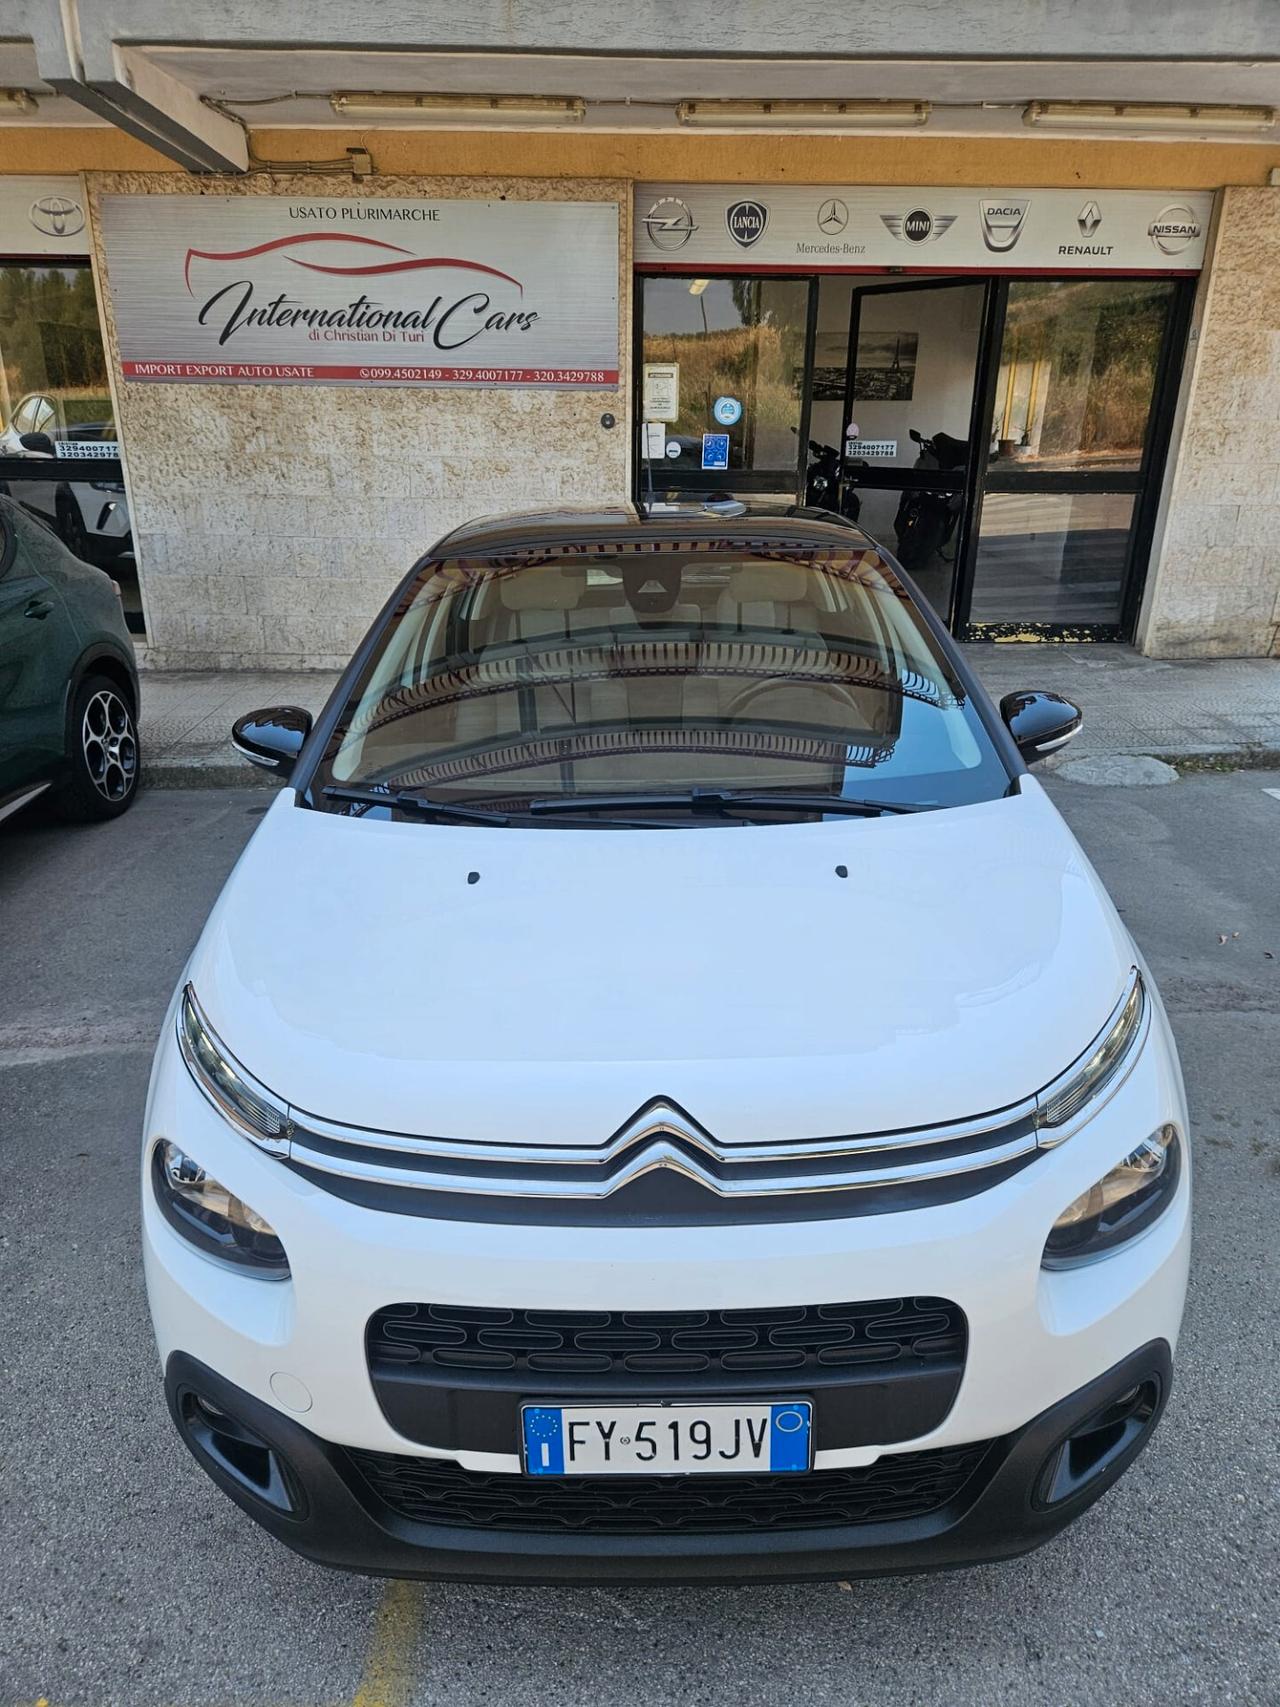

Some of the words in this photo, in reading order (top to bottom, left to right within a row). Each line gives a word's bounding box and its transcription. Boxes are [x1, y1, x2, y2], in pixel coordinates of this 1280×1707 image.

[289, 207, 337, 219] USATO
[341, 207, 440, 221] PLURIMARCHE
[987, 207, 1021, 216] DACIA
[733, 215, 760, 229] LANCIA
[905, 217, 930, 232] MINI
[1153, 224, 1196, 234] NISSAN
[796, 242, 866, 254] Mercedes-Benz
[1058, 246, 1114, 256] RENAULT
[198, 280, 443, 346] International
[433, 292, 541, 350] Cars
[308, 330, 320, 341] di
[323, 330, 378, 342] Christian
[382, 331, 396, 342] Di
[400, 332, 424, 343] Turi
[135, 364, 182, 376] IMPORT
[186, 365, 234, 377] EXPORT
[238, 366, 272, 377] AUTO
[276, 367, 314, 378] USATE
[370, 368, 442, 379] 099.4502149
[452, 371, 523, 381] 329.4007177
[533, 372, 604, 382] 320.3429788
[568, 1421, 616, 1461] FY
[634, 1418, 768, 1461] 519JV
